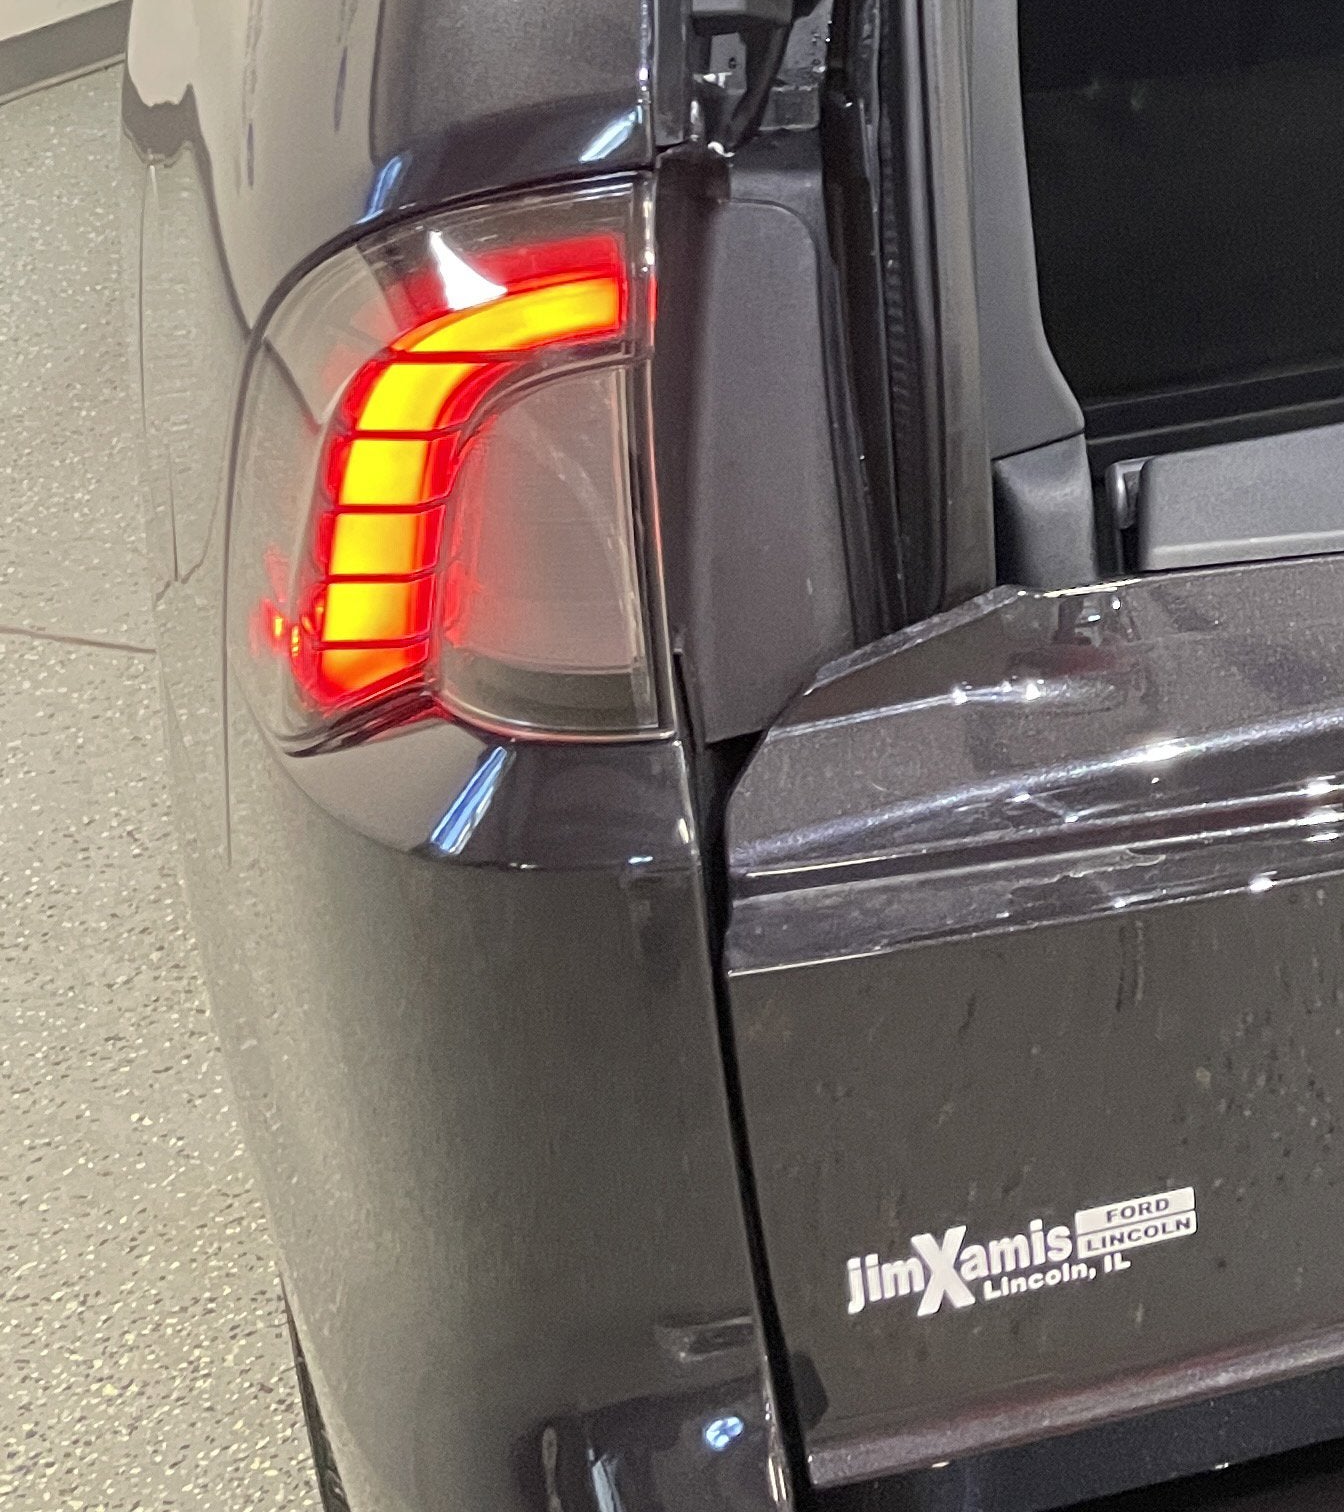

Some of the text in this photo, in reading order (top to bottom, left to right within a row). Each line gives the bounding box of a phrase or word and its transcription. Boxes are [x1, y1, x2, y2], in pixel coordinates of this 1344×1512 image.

[1105, 1198, 1170, 1224] FORD
[1086, 1216, 1192, 1253] LINCOLN
[983, 1252, 1132, 1301] Lincoln, IL
